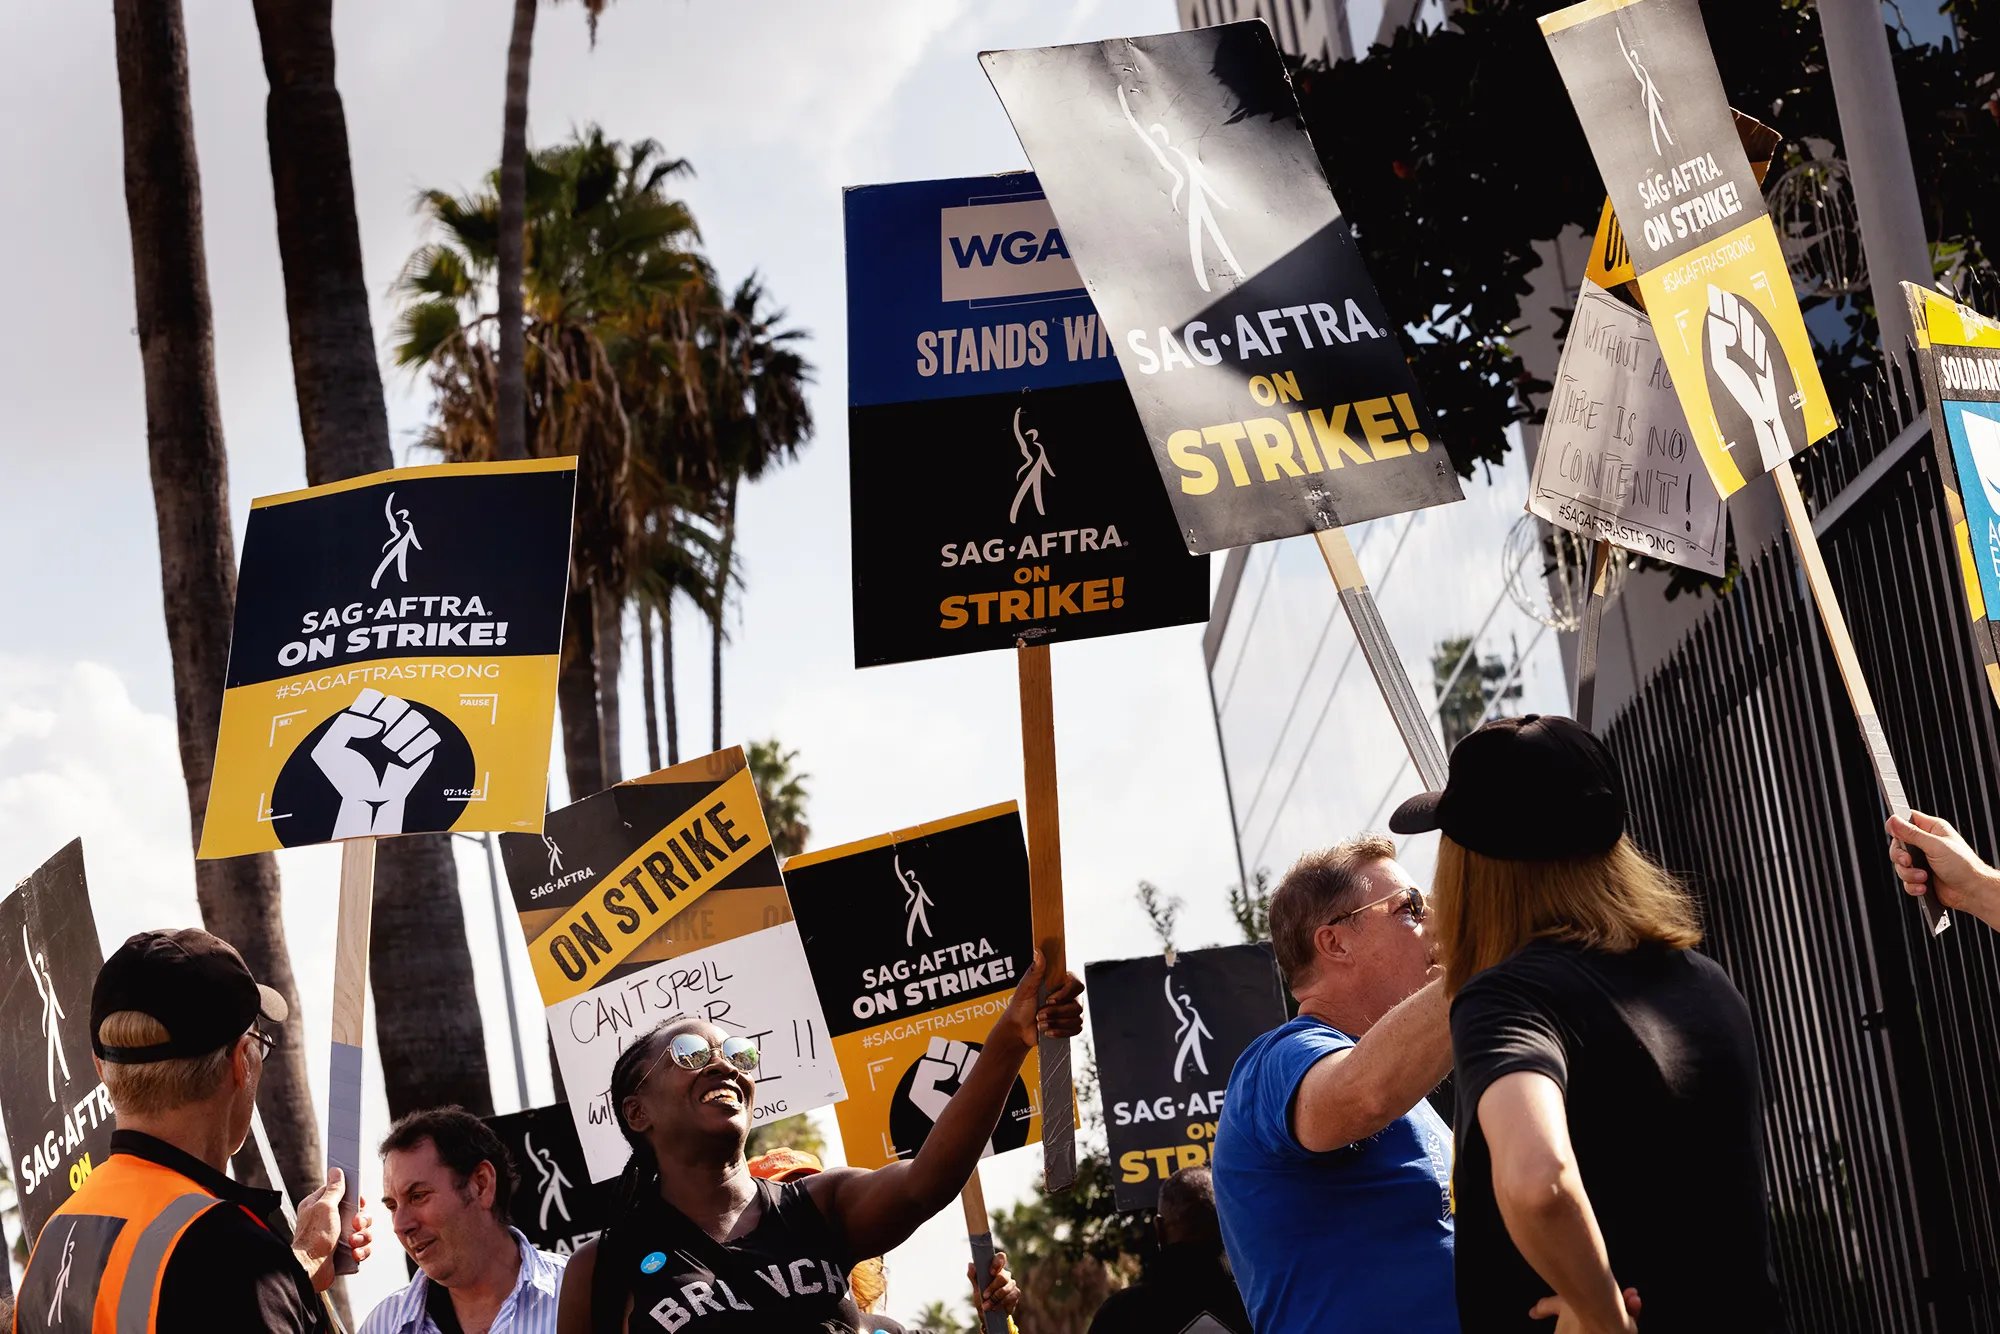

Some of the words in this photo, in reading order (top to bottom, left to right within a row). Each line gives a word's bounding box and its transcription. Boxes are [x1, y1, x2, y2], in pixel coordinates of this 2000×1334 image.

[1644, 213, 1674, 251] ON
[1671, 181, 1742, 239] STRIKE!
[1664, 234, 1756, 292] #SAGAFTRASTRONG
[916, 319, 1049, 378] STANDS
[1063, 314, 1116, 362] WI
[1585, 309, 1650, 372] WITHOUT
[1248, 370, 1303, 407] ON
[1560, 375, 1604, 431] THERE
[1613, 405, 1637, 446] IS
[1647, 425, 1687, 464] NO
[1167, 392, 1429, 496] STRIKE!
[939, 576, 1125, 629] STRIKE!
[1014, 565, 1050, 584] ON
[277, 634, 336, 667] ON
[345, 622, 509, 653] STRIKE!
[276, 664, 501, 699] #SAGAFTRASTRONG
[549, 911, 613, 981] ON
[602, 801, 751, 935] STRIKE
[853, 989, 898, 1019] ON
[904, 956, 1016, 1006] STRIKE!
